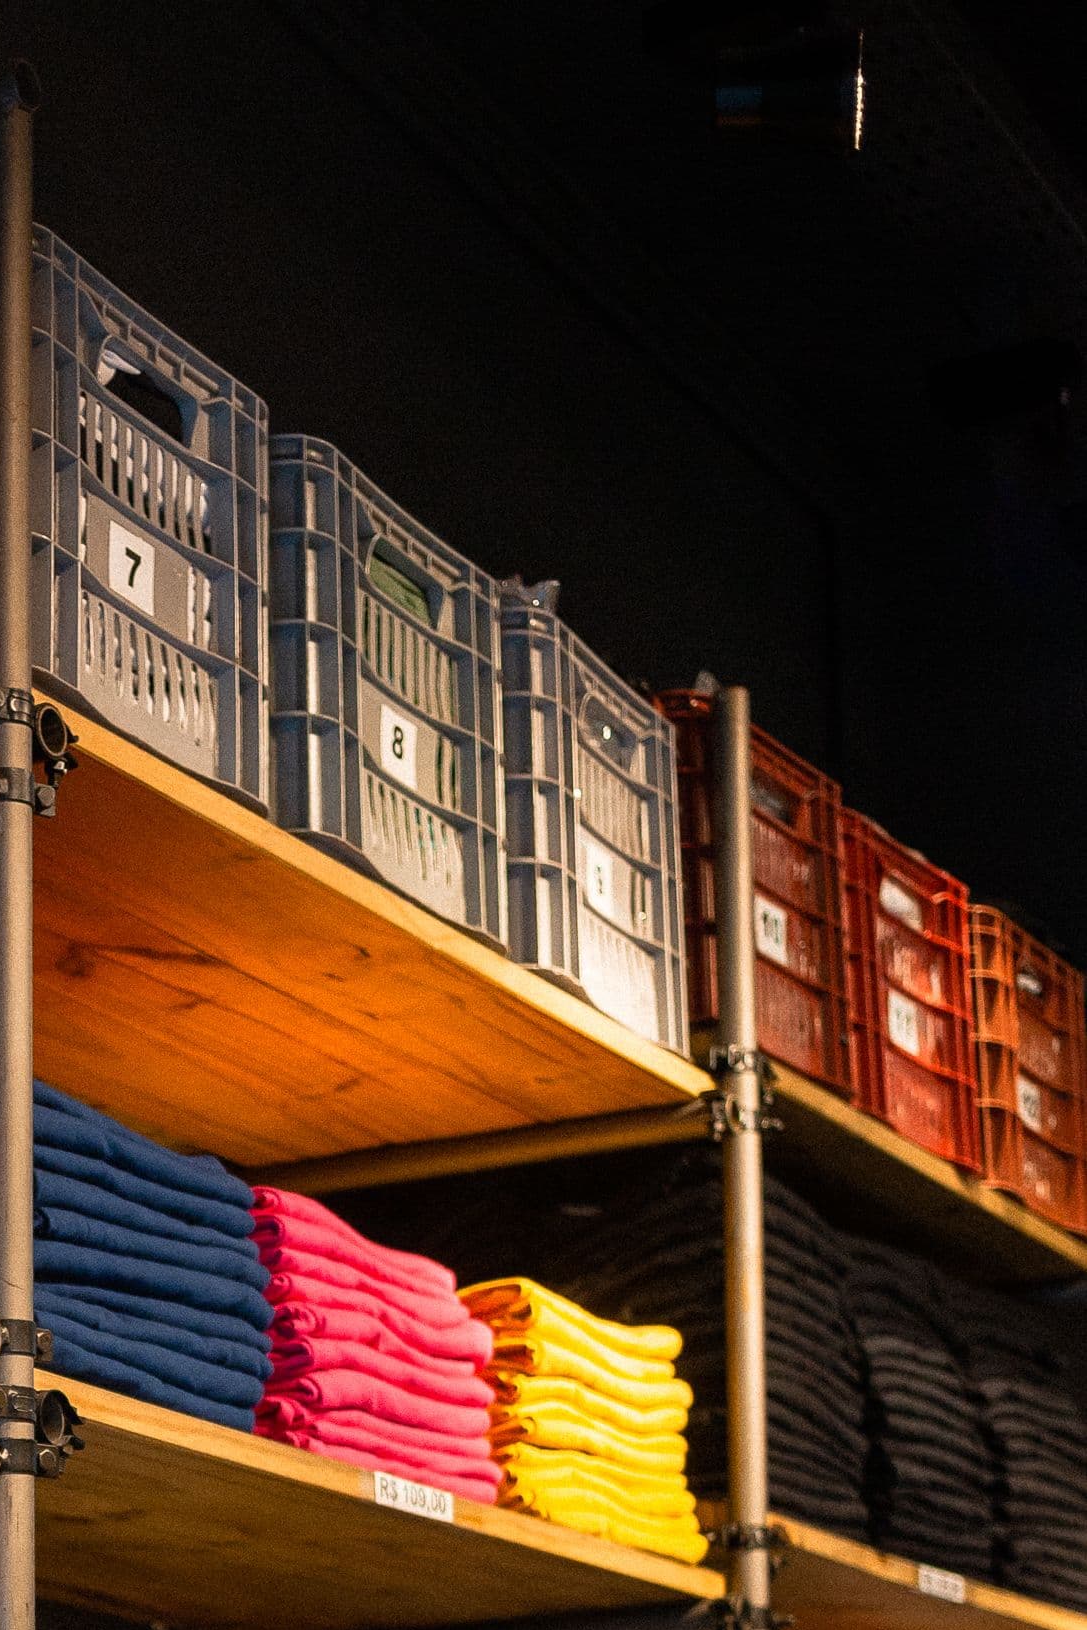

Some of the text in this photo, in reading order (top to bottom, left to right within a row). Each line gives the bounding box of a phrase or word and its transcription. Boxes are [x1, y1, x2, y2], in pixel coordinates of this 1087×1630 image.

[125, 547, 141, 588] 7
[393, 726, 404, 760] 8
[380, 1477, 398, 1501] R$
